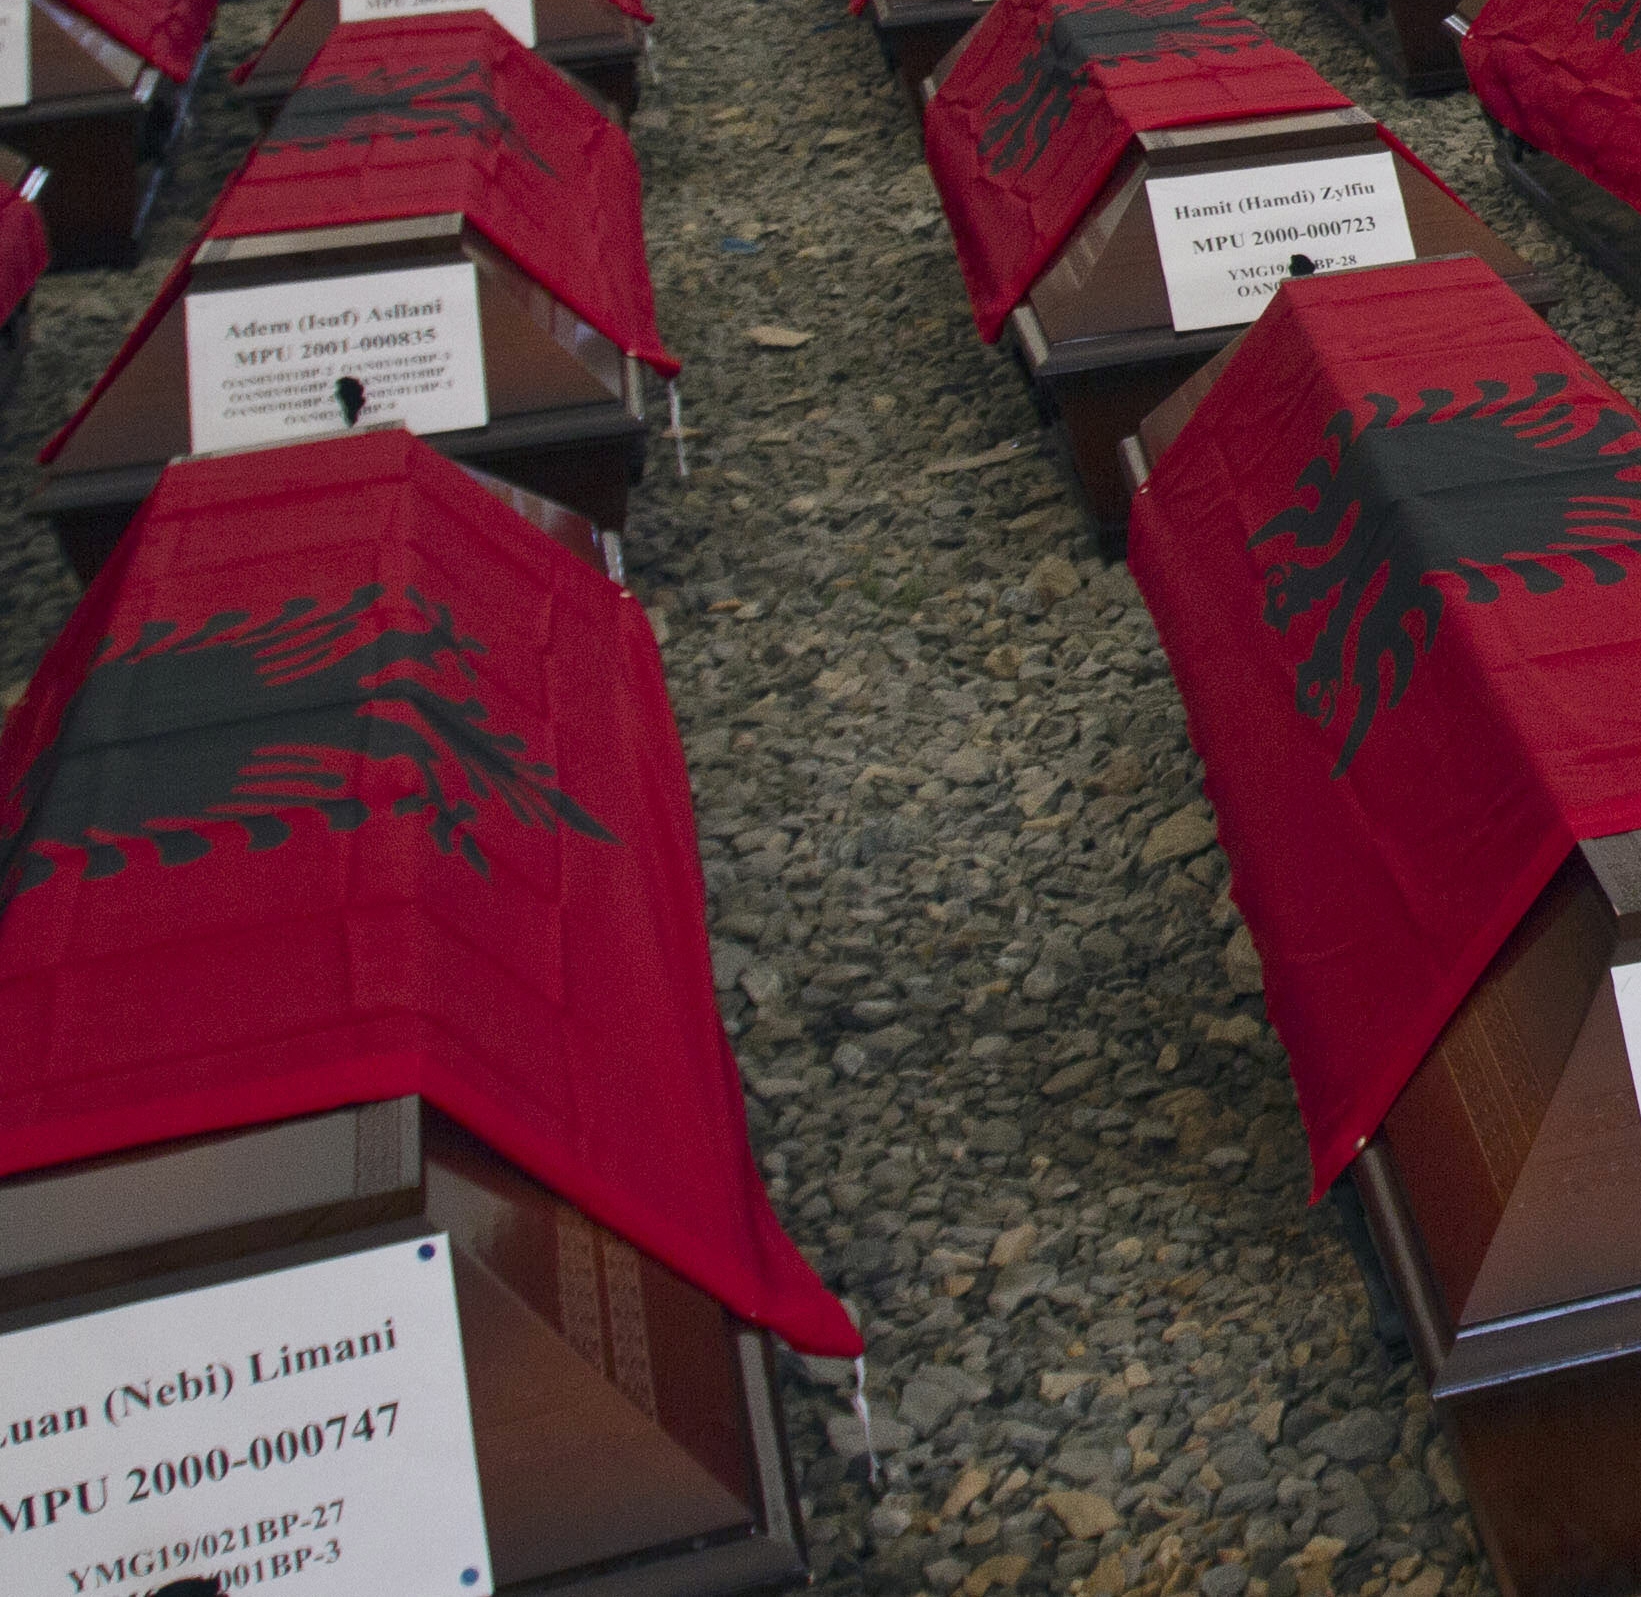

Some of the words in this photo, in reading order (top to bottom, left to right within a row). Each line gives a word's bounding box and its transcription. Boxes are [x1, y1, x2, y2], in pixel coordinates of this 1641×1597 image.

[1174, 200, 1233, 221] Hamit
[1237, 189, 1316, 215] (Hamdi)
[1320, 181, 1377, 204] Zylfiu
[1191, 232, 1247, 256] MPU
[1252, 215, 1378, 248] 2000-000723
[224, 318, 293, 341] Adem
[297, 309, 361, 335] (Isuf)
[365, 298, 443, 325] Asllani
[234, 345, 293, 369] MPU
[300, 328, 438, 361] 2001-000835
[102, 1359, 236, 1428] (Nebi)
[247, 1316, 399, 1388] Limani
[125, 1400, 401, 1506] 2000-000747
[65, 1497, 346, 1595] YMG19/021BP-27
